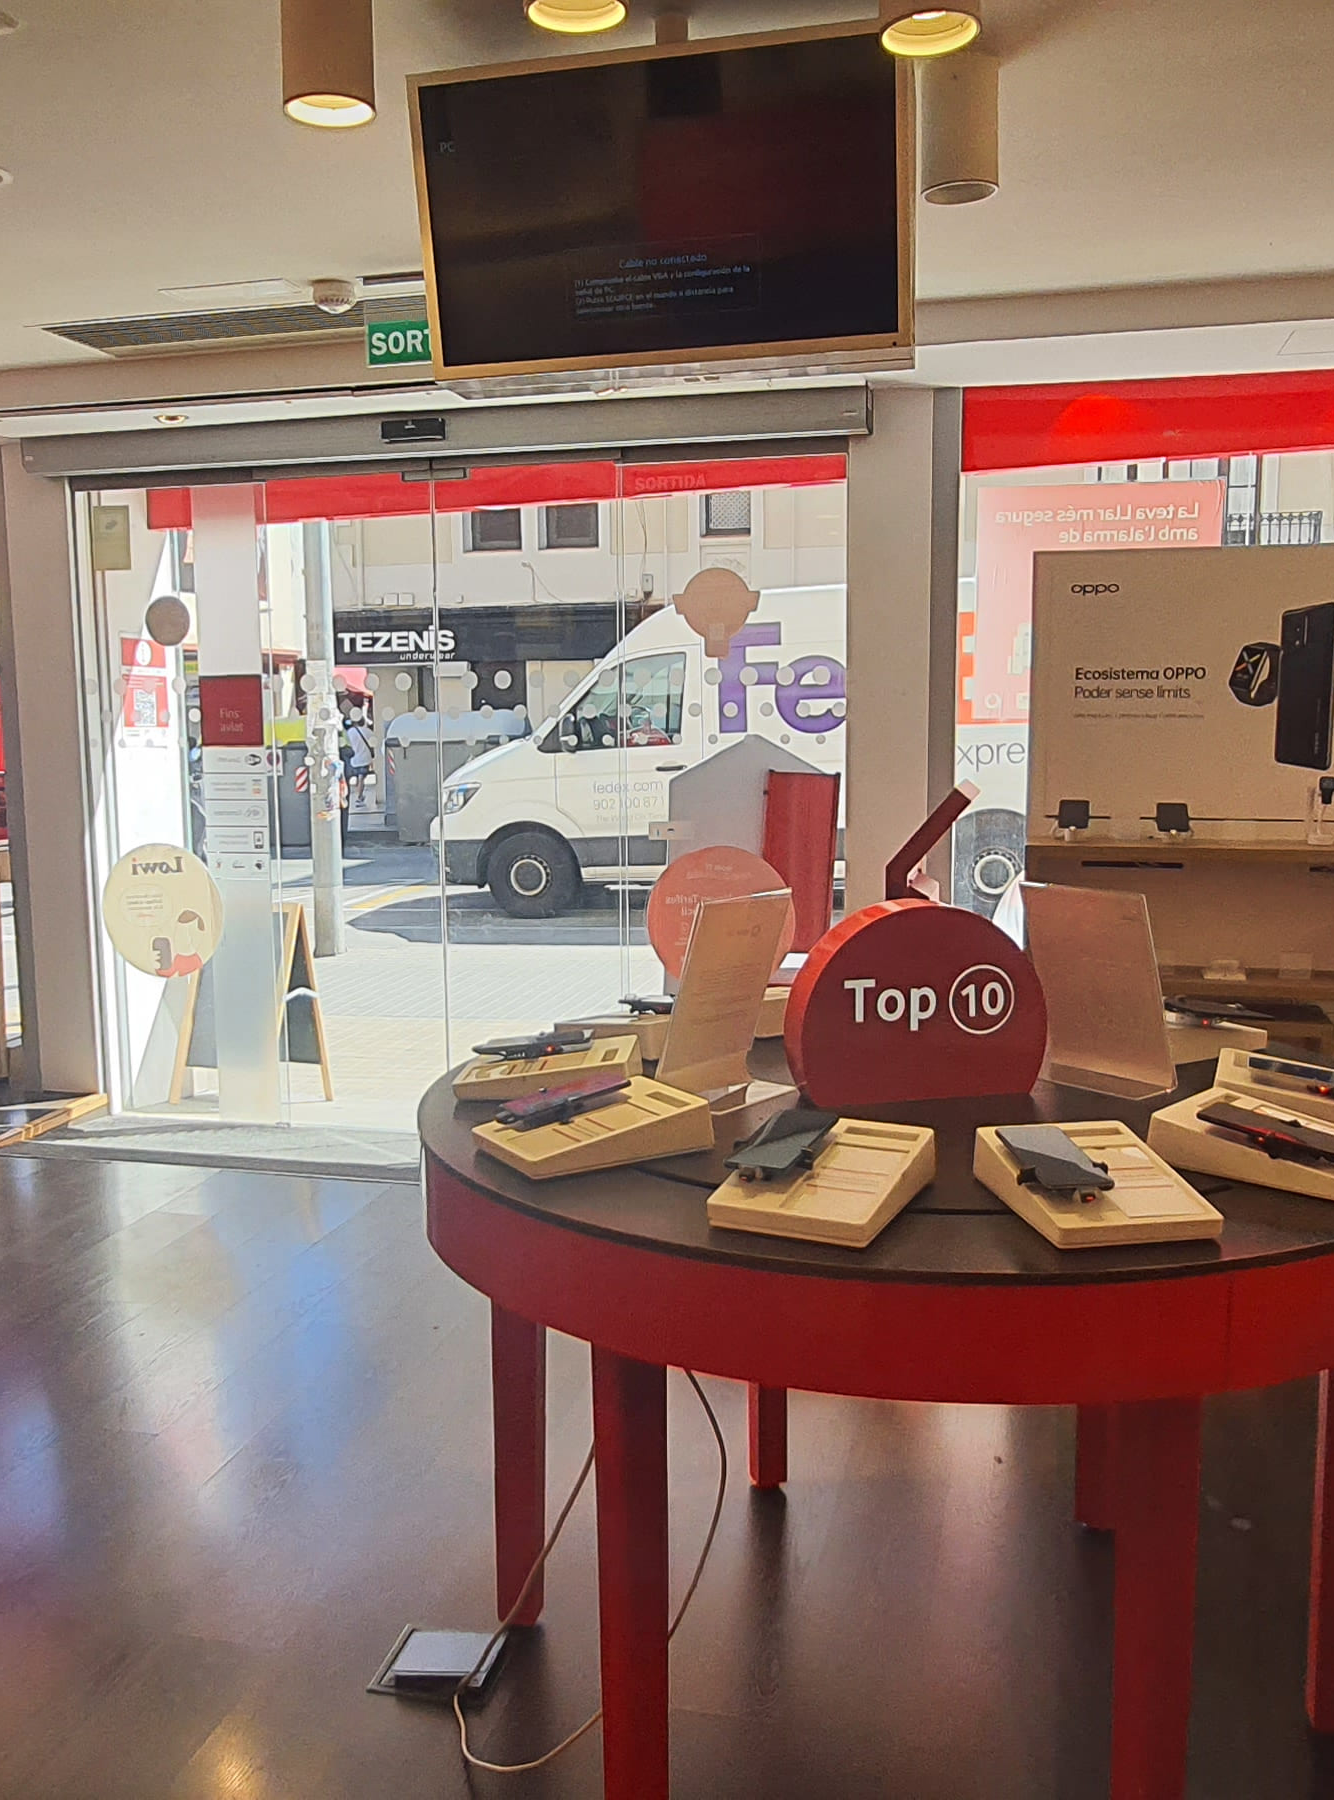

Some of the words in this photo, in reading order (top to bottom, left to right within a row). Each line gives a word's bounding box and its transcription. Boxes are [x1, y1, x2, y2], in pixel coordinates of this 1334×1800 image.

[1075, 667, 1159, 680] Ecosistema
[1163, 666, 1206, 680] OPPO
[1074, 685, 1112, 699] Poder
[1115, 688, 1154, 699] sense
[957, 742, 1025, 772] xpre
[843, 979, 937, 1032] Top
[960, 981, 1005, 1018] 10
